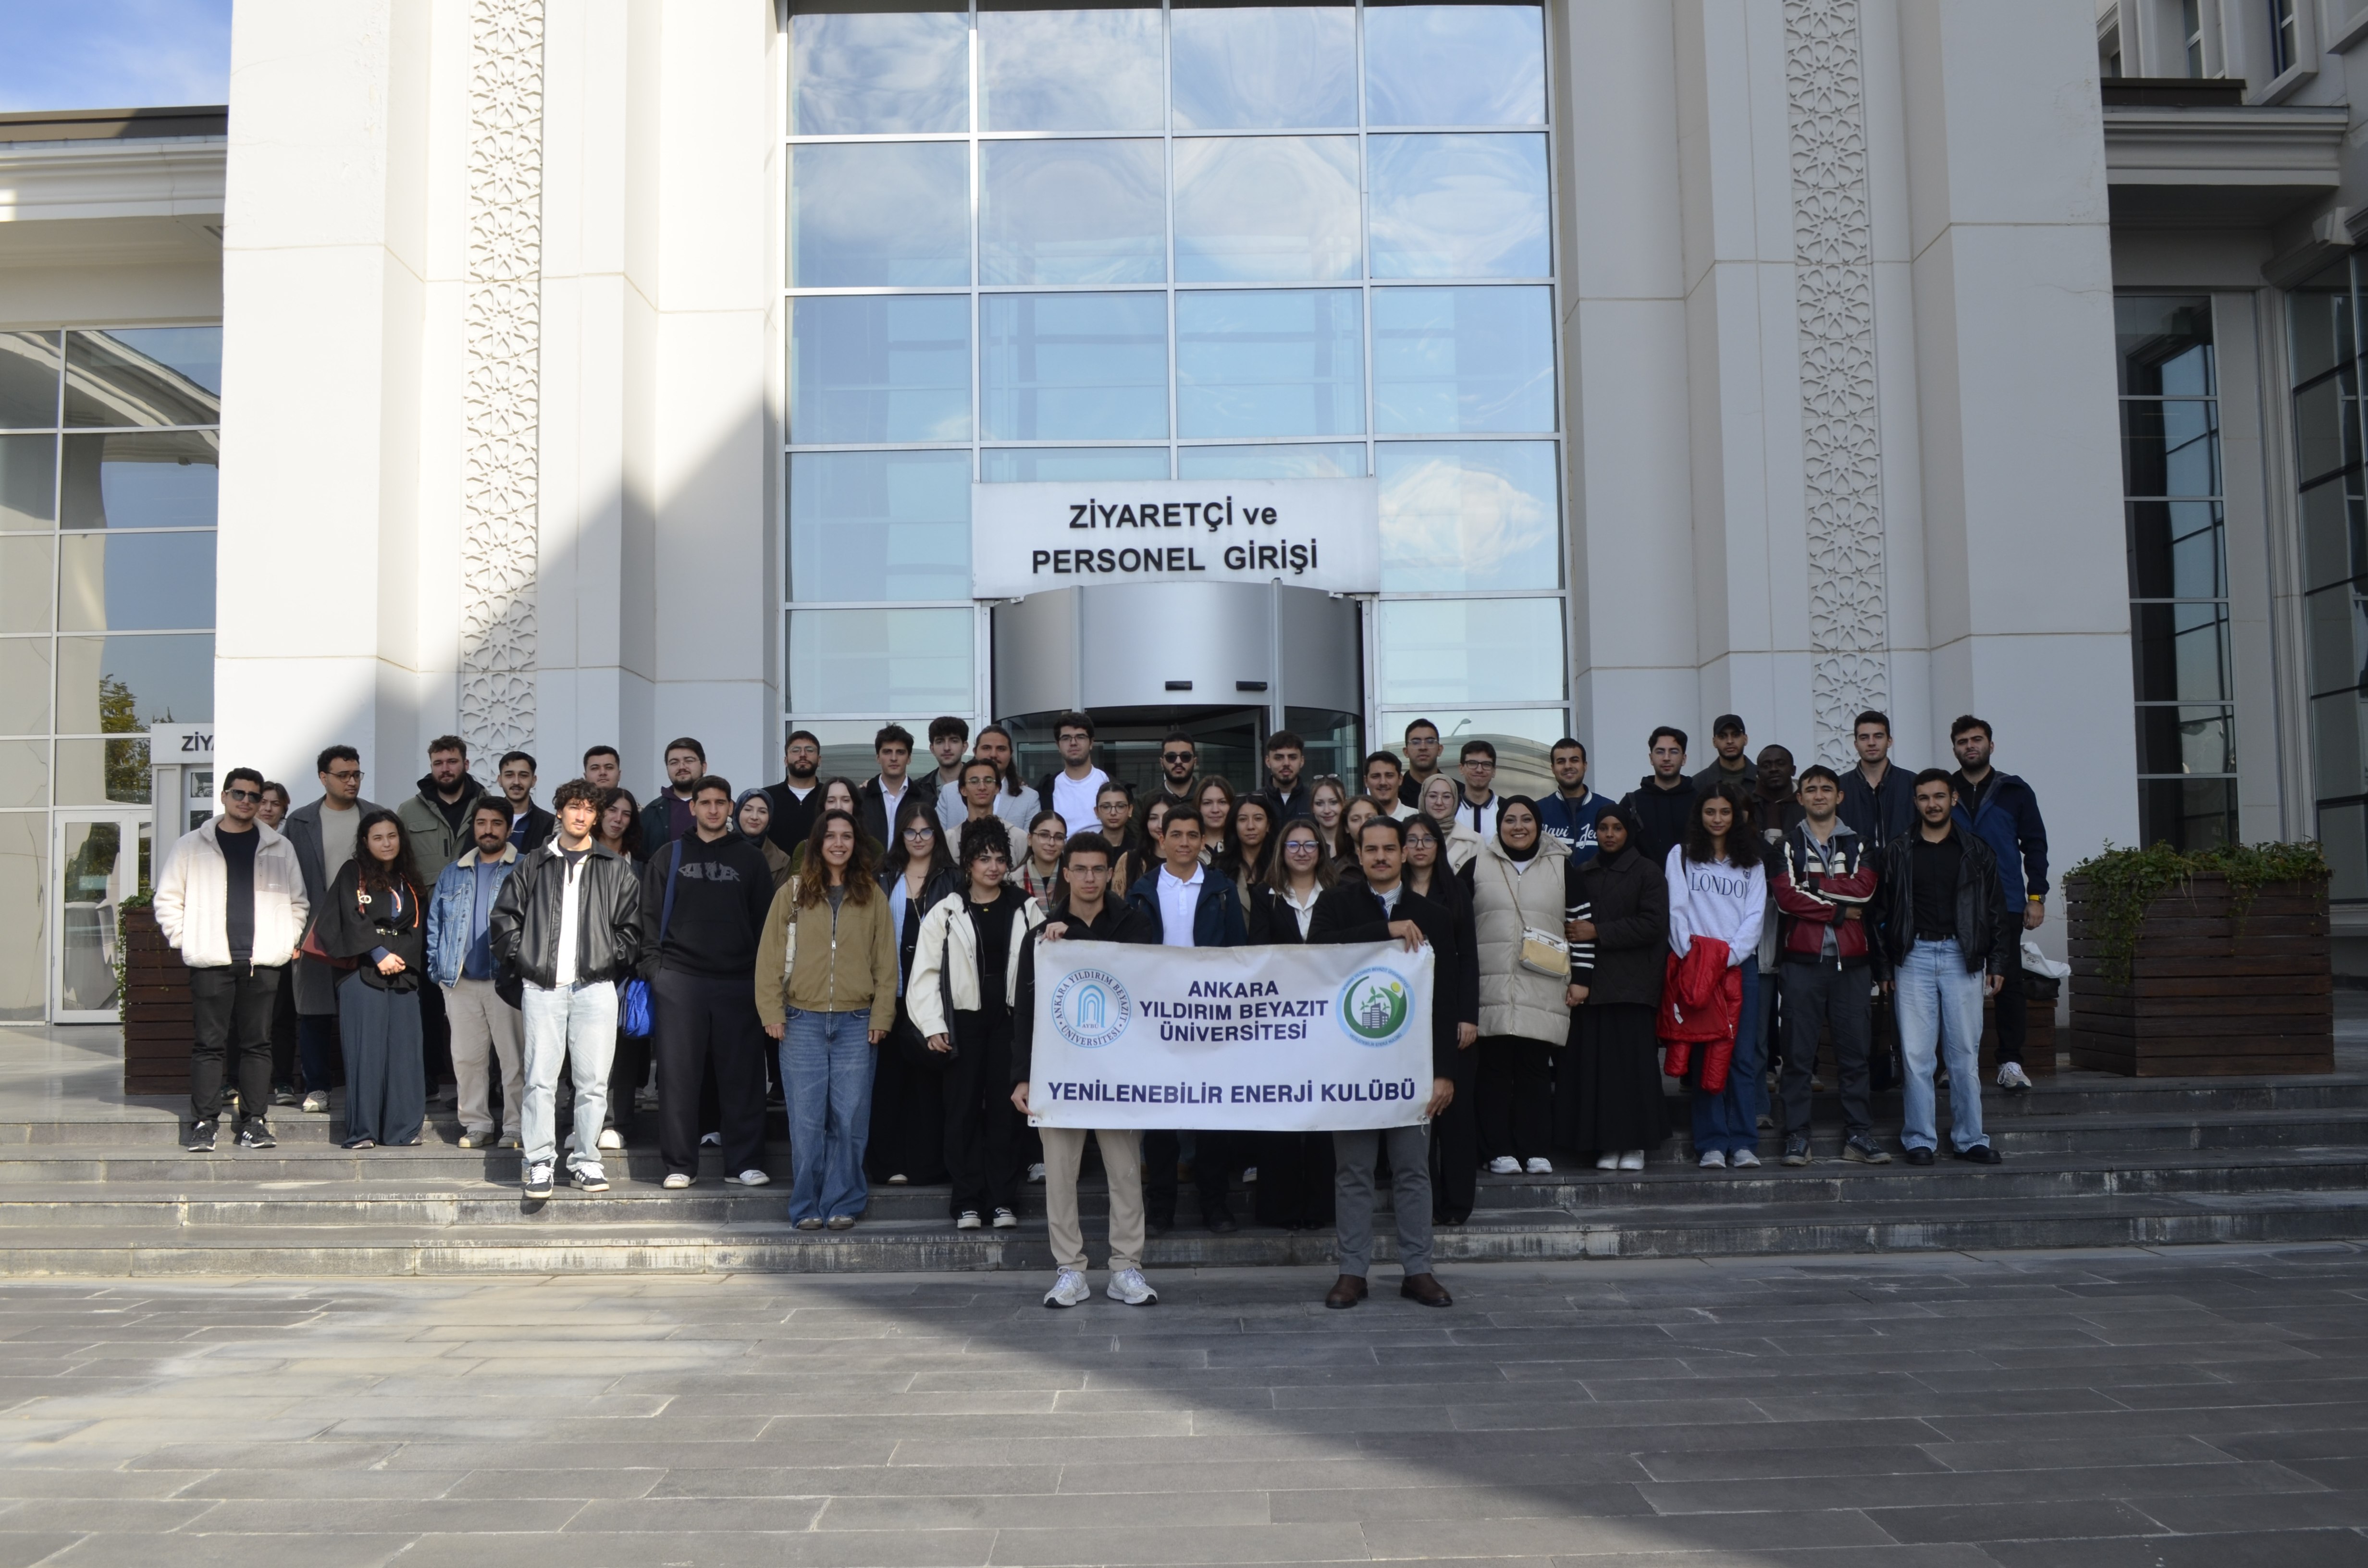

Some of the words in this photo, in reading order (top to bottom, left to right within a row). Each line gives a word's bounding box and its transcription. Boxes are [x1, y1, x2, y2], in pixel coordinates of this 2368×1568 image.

[1070, 496, 1232, 532] ZİYARETÇİ
[1243, 507, 1277, 525] ve
[1033, 548, 1205, 574] PERSONEL
[1224, 539, 1317, 575] GİRİŞİ
[182, 732, 214, 751] ZİY
[1054, 983, 1070, 1018] ANKARA
[1068, 971, 1113, 985] YILDIRIM
[1112, 984, 1129, 1023] BEYAZIT
[1188, 980, 1279, 998] ANKARA
[1140, 1001, 1231, 1020] YILDIRIM
[1240, 1001, 1328, 1018] BEYAZIT
[1061, 1025, 1121, 1046] ÜNİVERSİTESİ
[1160, 1020, 1306, 1041] ÜNİVERSİTESİ
[1048, 1079, 1222, 1103] YENİLENEBİLİR
[1231, 1080, 1312, 1102] ENERJİ
[1322, 1078, 1414, 1102] KULÜBÜ
